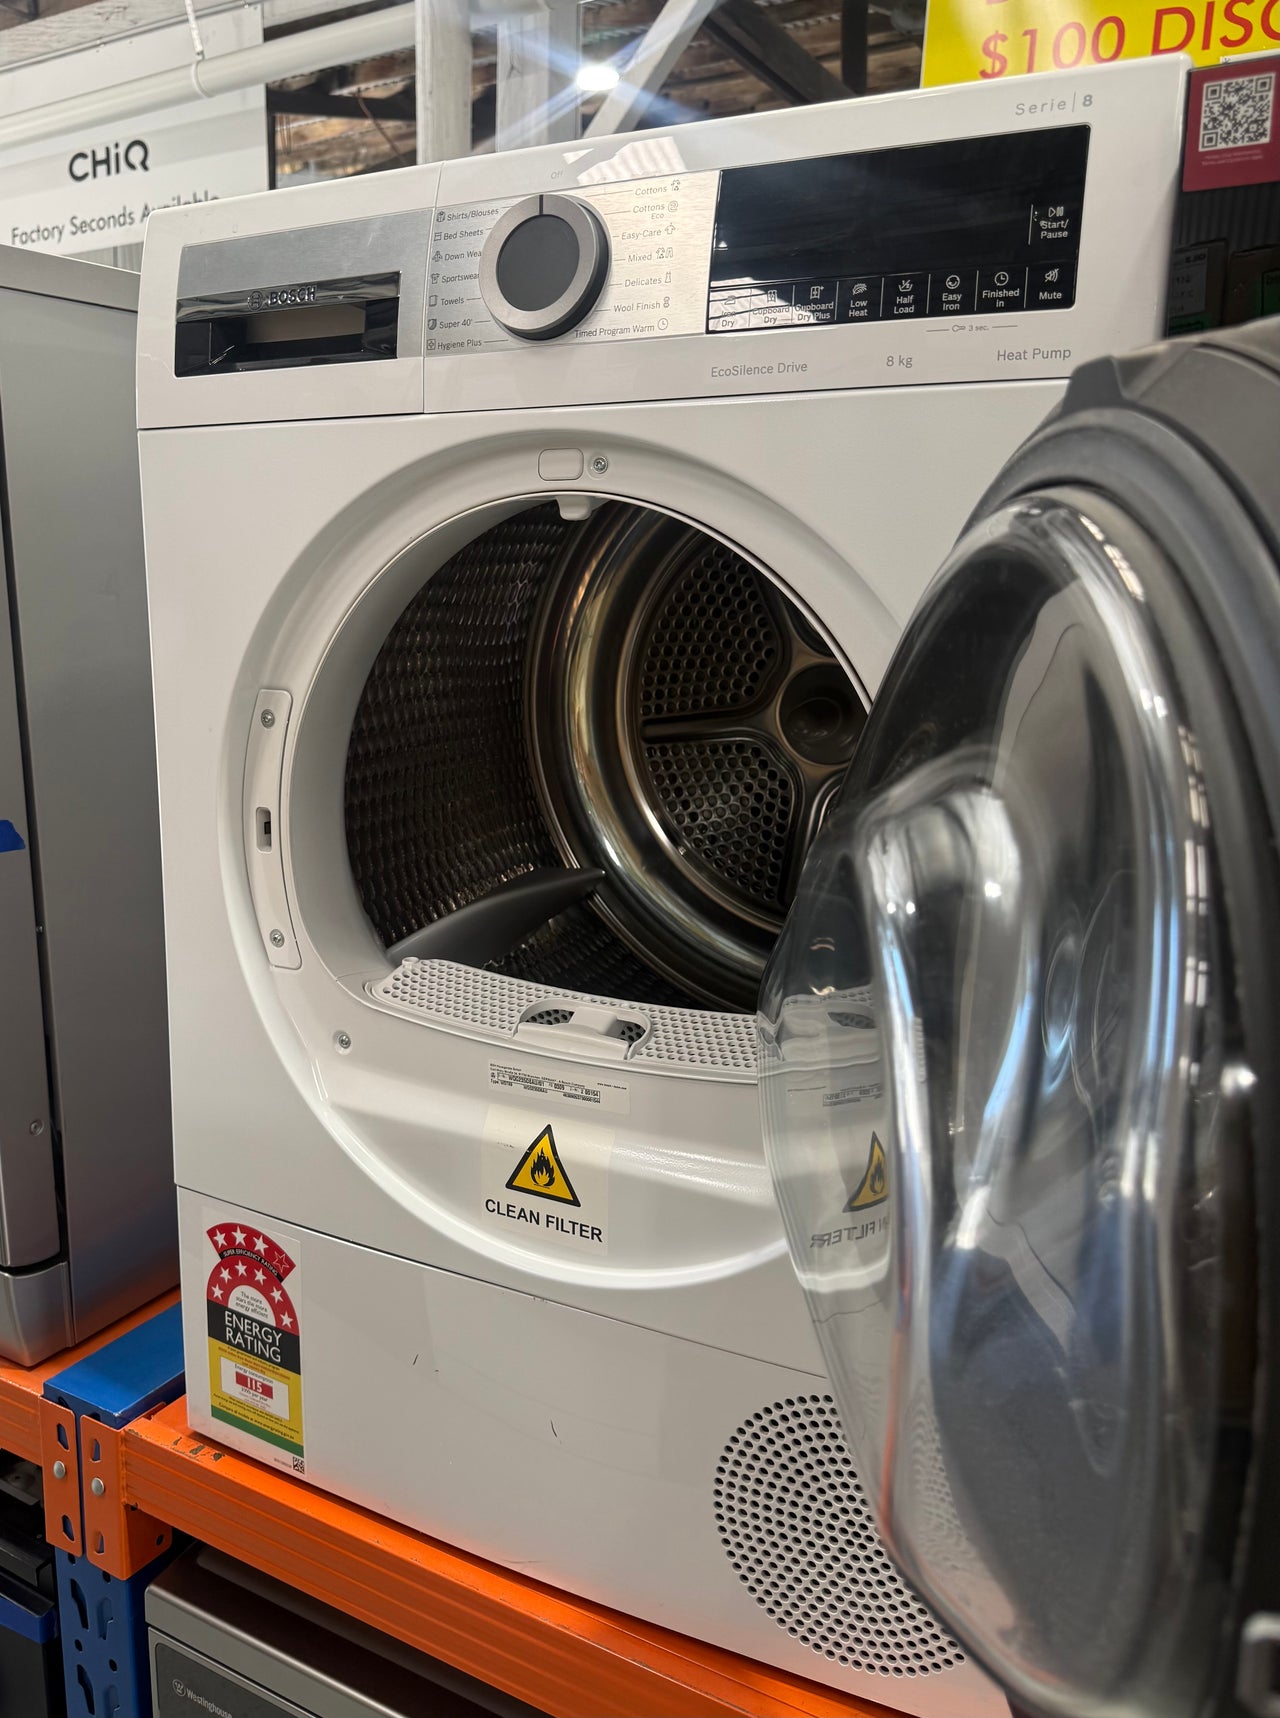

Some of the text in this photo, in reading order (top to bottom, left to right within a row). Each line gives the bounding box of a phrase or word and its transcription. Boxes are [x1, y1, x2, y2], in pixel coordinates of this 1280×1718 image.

[979, 16, 1126, 80] $100
[1015, 94, 1093, 116] Serie 8
[635, 186, 667, 196] Cottons
[633, 204, 665, 213] Cottons
[447, 208, 499, 221] Shirts/Blouses
[11, 223, 65, 246] Factory
[70, 206, 135, 236] Seconds
[443, 229, 484, 241] Bed Sheets
[621, 229, 662, 240] Easy-Care
[1040, 231, 1069, 239] Pause
[444, 250, 482, 261] Down Wea
[628, 252, 653, 262] Mixed
[624, 277, 662, 287] Delicates
[268, 285, 317, 305] BOSCH
[942, 292, 962, 302] Easy
[982, 288, 1020, 299] Finished
[1038, 291, 1063, 300] Mute
[441, 296, 465, 306] Towels
[850, 299, 868, 308] Low
[896, 295, 914, 304] Half
[996, 299, 1005, 308] in
[613, 301, 660, 313] Wool Finish
[752, 306, 790, 315] Cupboard
[794, 301, 834, 312] Cupboard
[894, 305, 915, 314] Load
[942, 302, 960, 311] Iron
[797, 311, 831, 322] Dry Plus
[849, 308, 868, 317] Heat
[439, 320, 460, 330] Super
[721, 319, 735, 328] Dry
[764, 316, 777, 324] Dry
[575, 325, 654, 338] Timed Program Warm
[437, 339, 482, 351] Hygiene Plus
[997, 348, 1071, 363] Heat Pump
[886, 355, 913, 369] 8 kg
[711, 361, 808, 378] EcoSilence Drive
[485, 1199, 603, 1243] CLEAN FILTER
[224, 1310, 282, 1347] ENERGY
[225, 1326, 281, 1363] RATING
[247, 1377, 263, 1393] 115
[186, 1688, 233, 1718] Westinghouse
